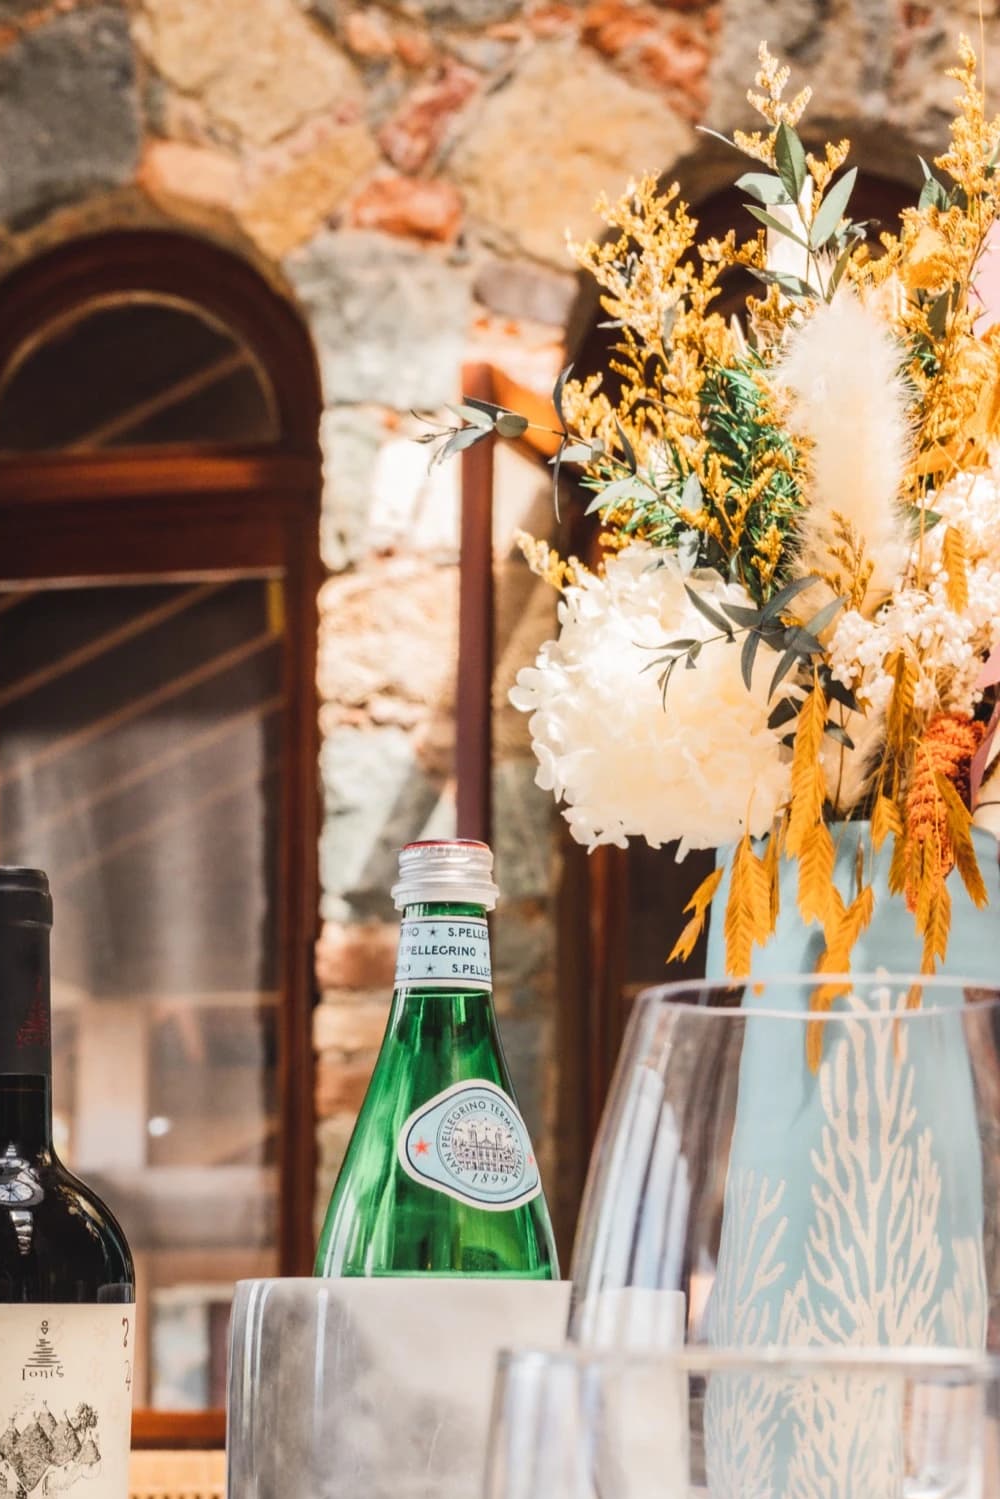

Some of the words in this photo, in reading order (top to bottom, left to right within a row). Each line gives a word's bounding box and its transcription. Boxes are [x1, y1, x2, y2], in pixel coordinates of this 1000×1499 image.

[442, 1100, 486, 1148] PELLEGRINO
[444, 1152, 463, 1175] SAN
[471, 1172, 508, 1185] 1899
